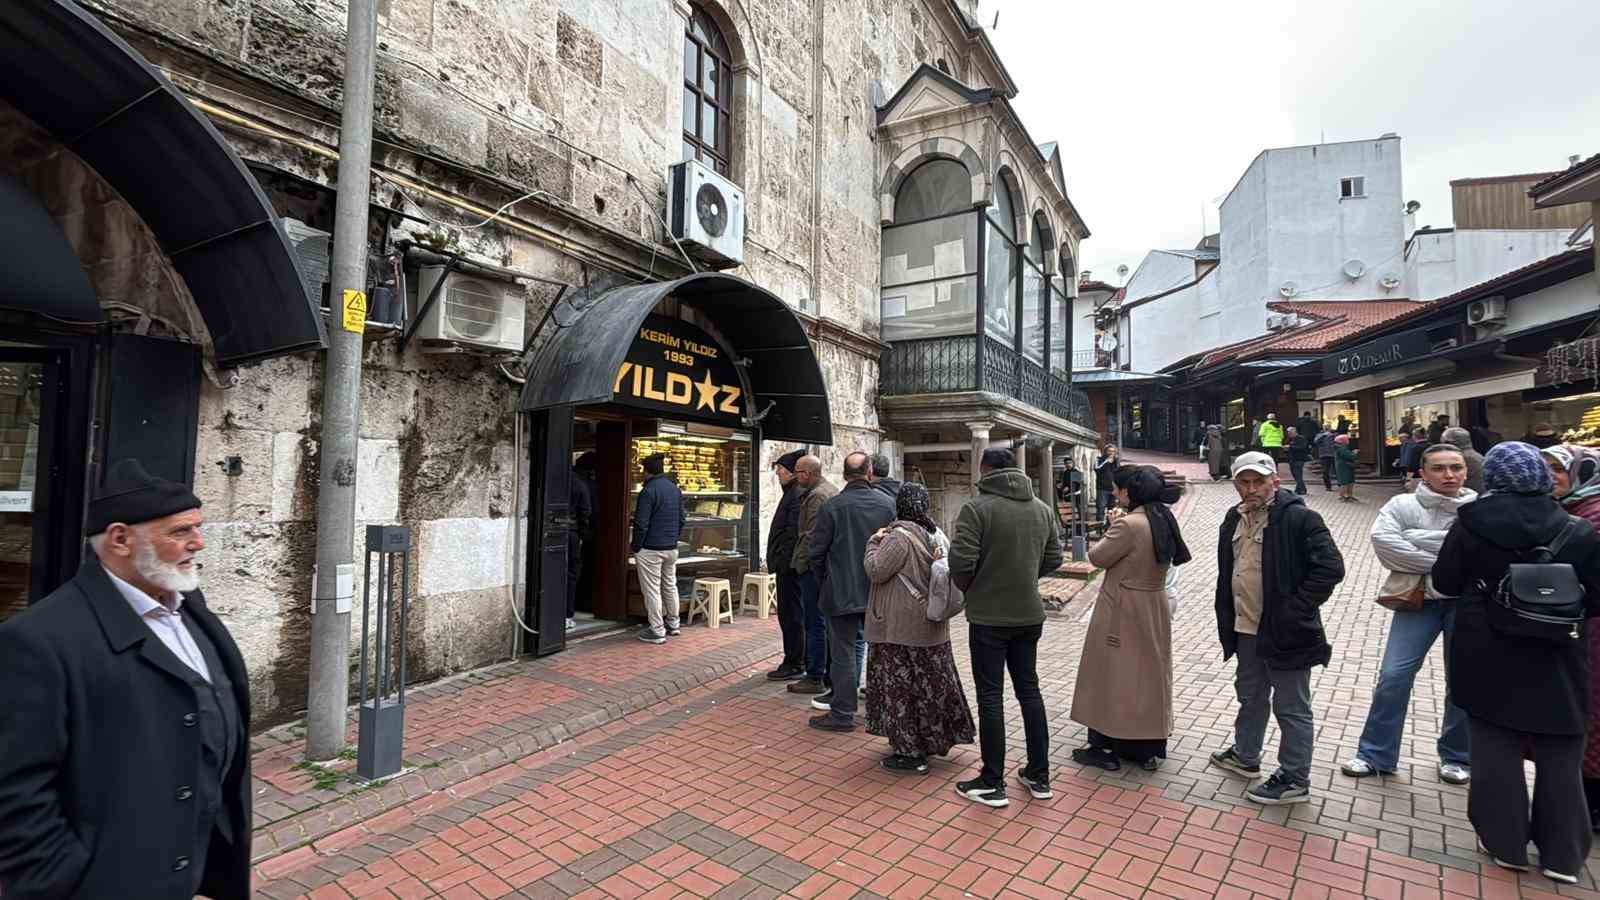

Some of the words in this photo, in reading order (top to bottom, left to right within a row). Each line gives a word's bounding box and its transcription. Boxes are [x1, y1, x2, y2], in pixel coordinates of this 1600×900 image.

[640, 327, 680, 348] KERİM
[683, 340, 718, 358] YILDIZ
[663, 350, 694, 366] 1993
